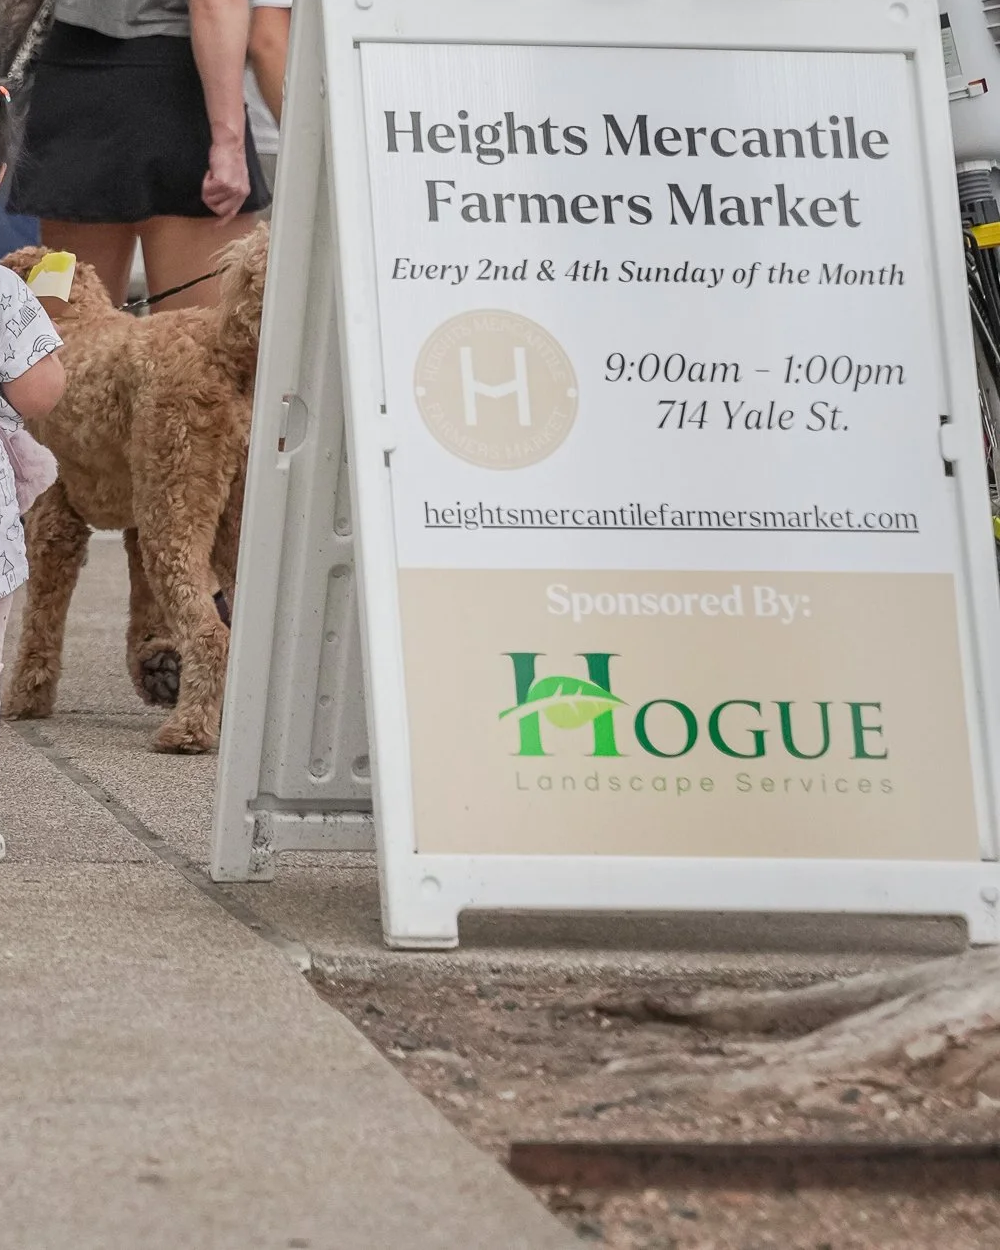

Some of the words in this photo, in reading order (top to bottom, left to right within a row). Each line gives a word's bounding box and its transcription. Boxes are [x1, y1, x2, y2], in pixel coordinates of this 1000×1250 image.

[384, 110, 589, 166] Heights
[602, 114, 889, 160] Mercantile
[425, 179, 653, 225] Farmers
[667, 182, 862, 228] Market
[391, 257, 469, 286] Every
[476, 258, 528, 282] 2nd
[536, 259, 557, 282] &
[564, 259, 609, 282] 4th
[618, 260, 725, 289] Sunday
[732, 261, 762, 290] of
[768, 262, 811, 285] the
[818, 263, 906, 286] Month
[459, 346, 532, 426] H
[604, 352, 743, 384] 9:00am
[782, 353, 908, 392] 1:00pm
[656, 399, 709, 430] 714
[721, 400, 795, 431] Yale
[806, 401, 850, 432] St.
[424, 501, 919, 532] heightsmercantilefarmersmarket.com
[545, 582, 746, 623] Sponsored
[753, 585, 813, 625] By:
[499, 651, 890, 760] HOGUE
[515, 771, 716, 797] Landscape
[736, 772, 895, 795] Services
